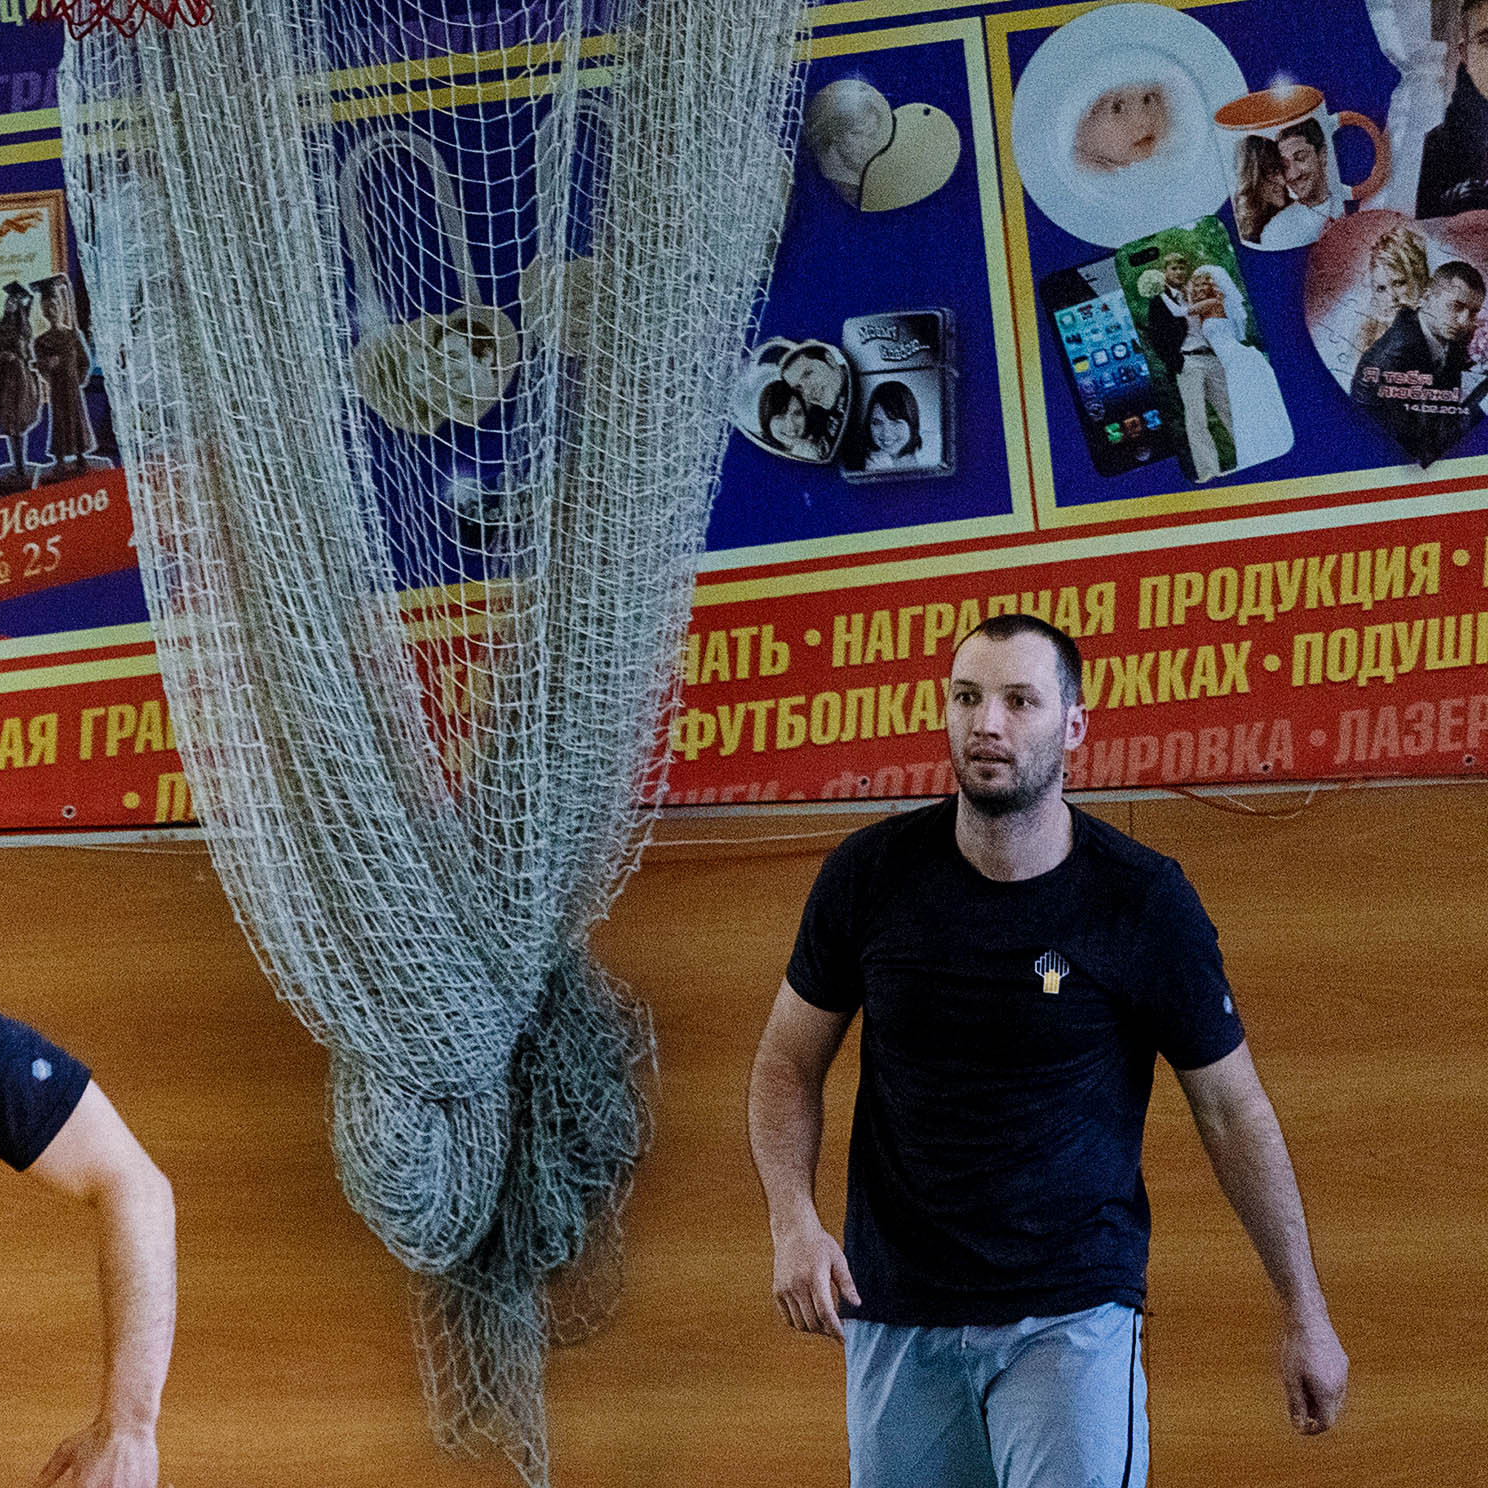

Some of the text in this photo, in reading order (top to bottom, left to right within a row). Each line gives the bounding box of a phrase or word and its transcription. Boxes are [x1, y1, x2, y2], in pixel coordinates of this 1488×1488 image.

[23, 535, 64, 577] 25
[1138, 541, 1441, 631] ПРОДУКЦИЯ
[671, 680, 952, 761] ФУТБОЛКА
